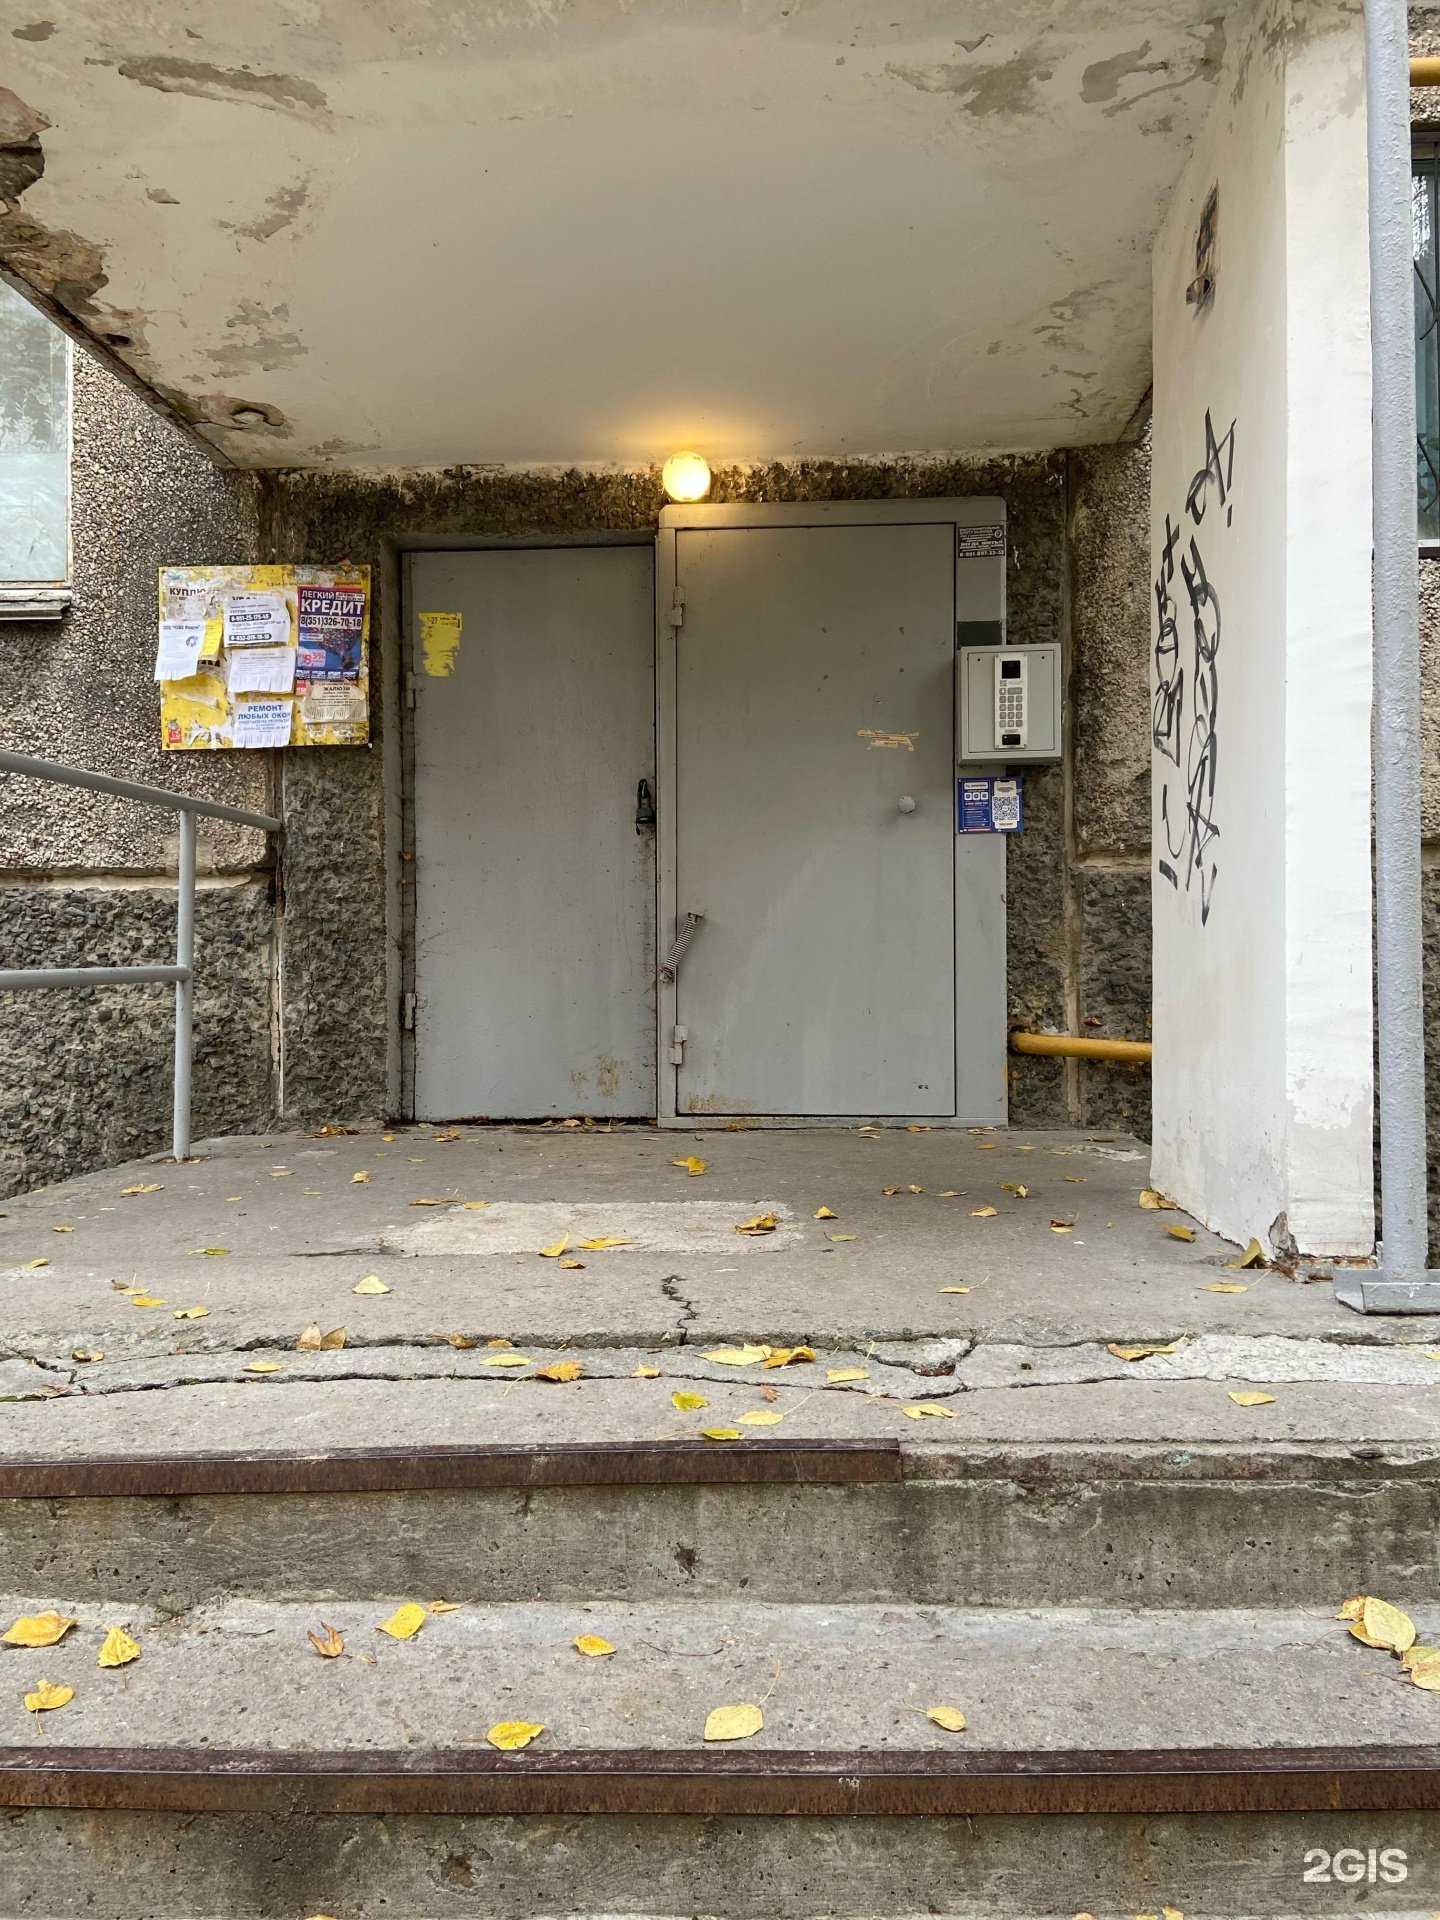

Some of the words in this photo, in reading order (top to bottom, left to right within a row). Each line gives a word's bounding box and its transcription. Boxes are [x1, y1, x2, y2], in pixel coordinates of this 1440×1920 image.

[301, 590, 335, 600] ЛЕГКИЙ
[300, 599, 365, 616] КРЕДИТ
[300, 616, 362, 627] 8(351)326-70-18
[247, 704, 284, 712] РЕМОНТ
[238, 712, 269, 720] ЛЮБЫХ
